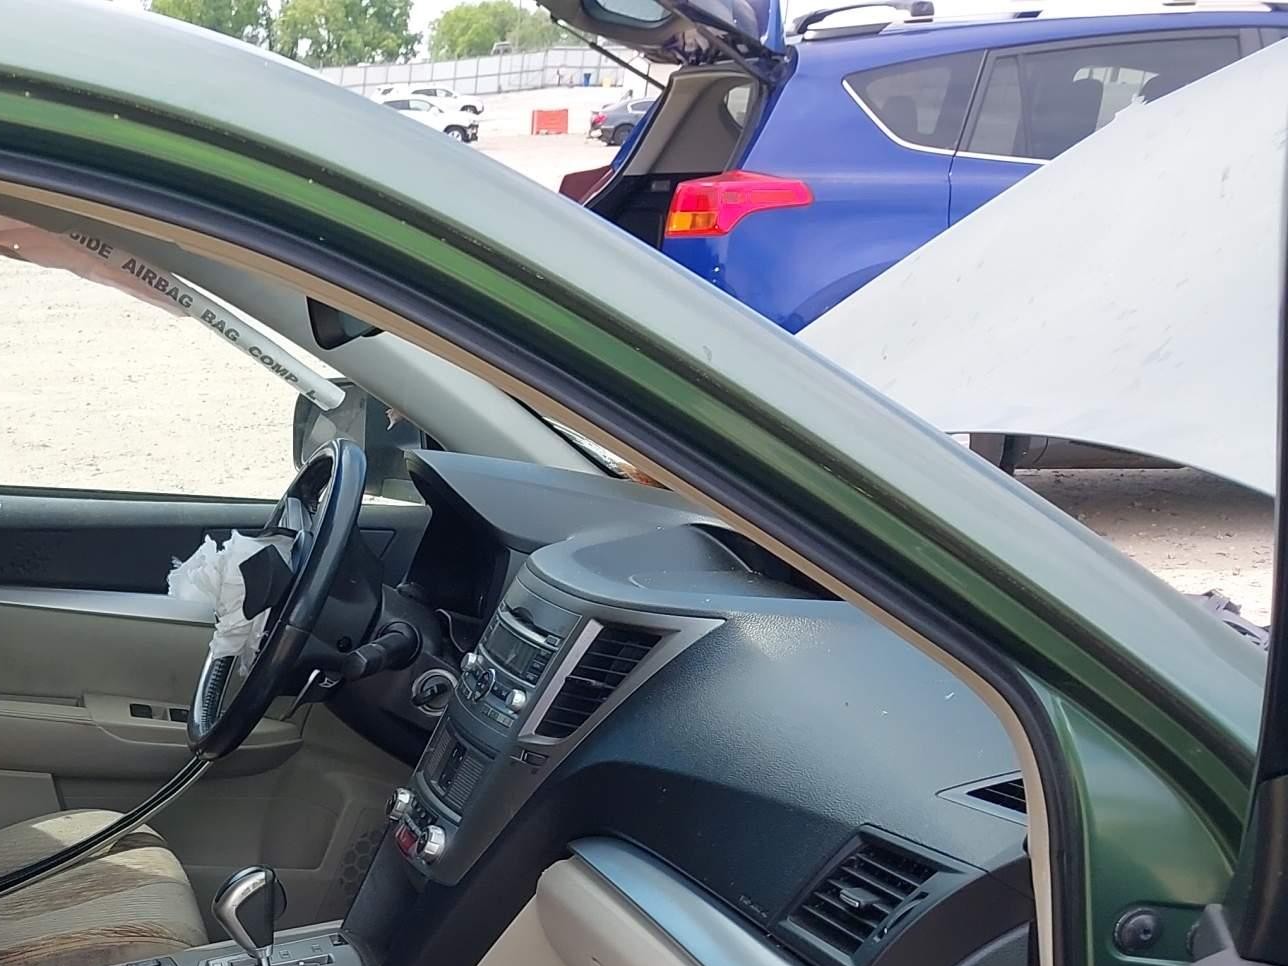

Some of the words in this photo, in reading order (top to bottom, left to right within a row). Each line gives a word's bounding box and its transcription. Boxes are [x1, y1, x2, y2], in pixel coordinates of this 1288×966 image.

[121, 258, 193, 309] AIRBAG
[200, 308, 240, 342] BAG
[248, 345, 299, 383] COMP
